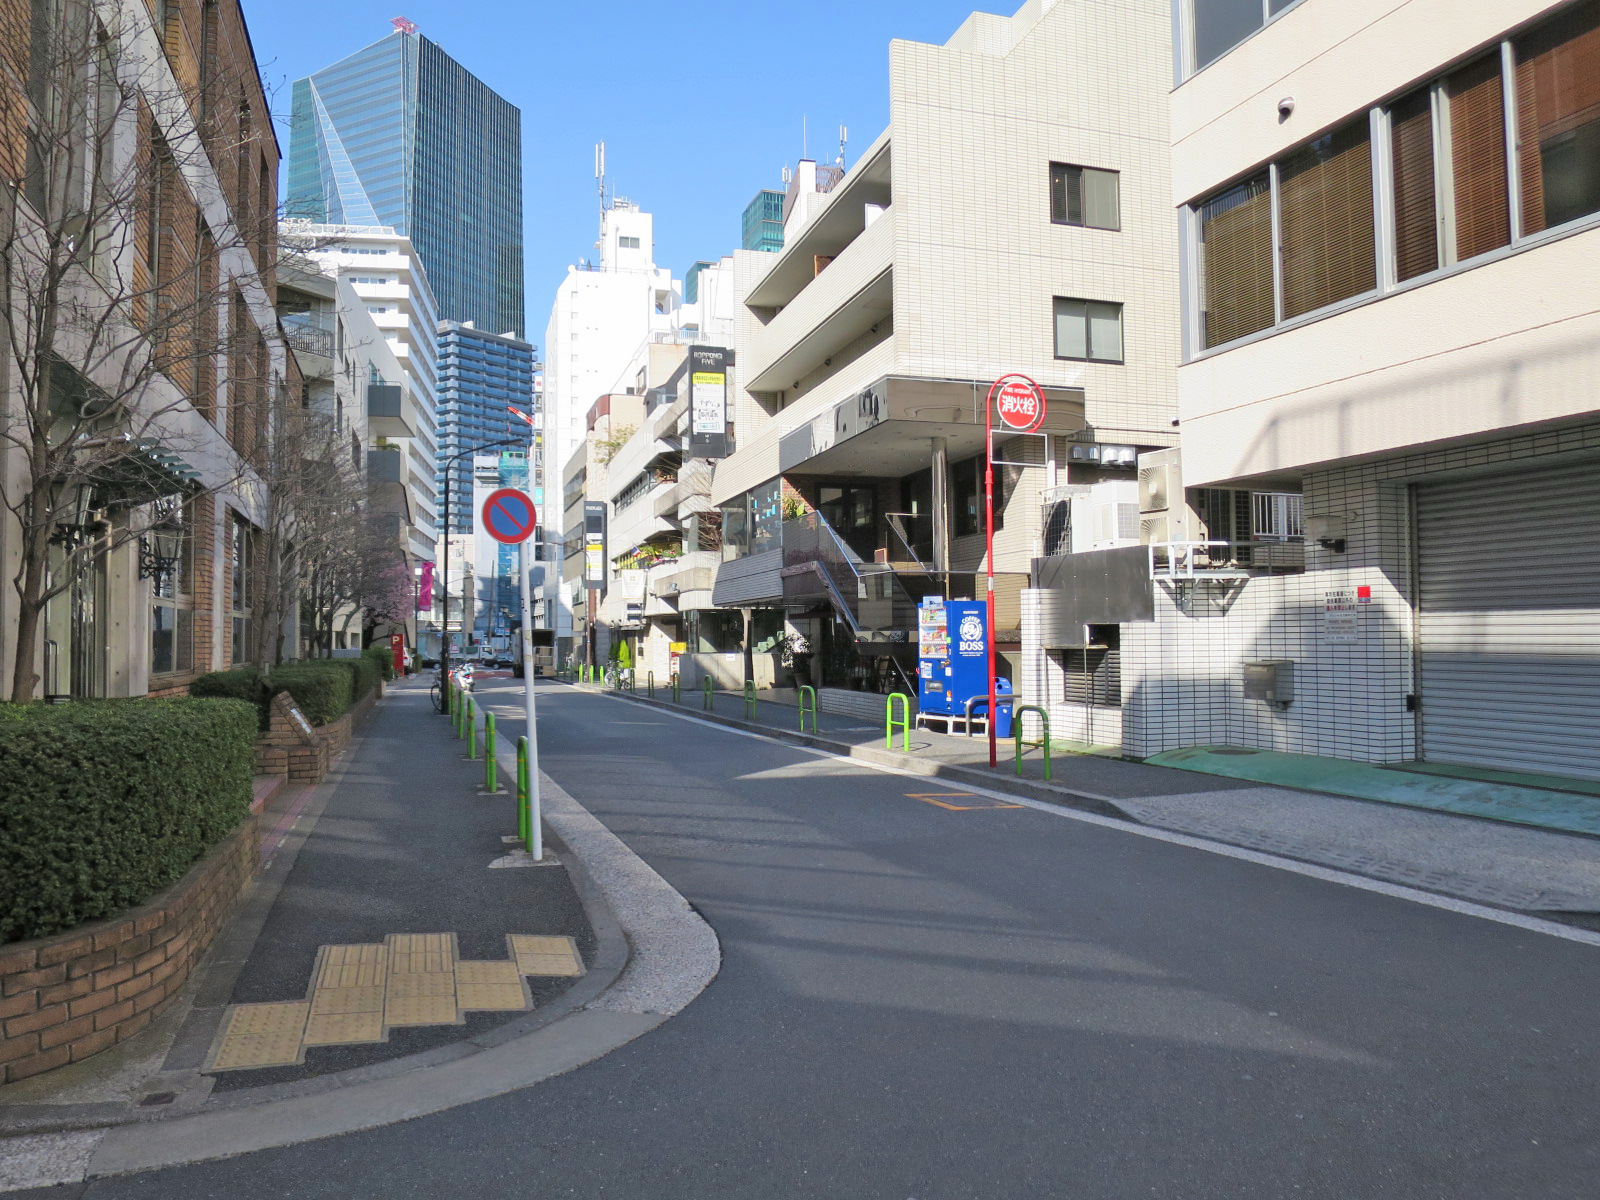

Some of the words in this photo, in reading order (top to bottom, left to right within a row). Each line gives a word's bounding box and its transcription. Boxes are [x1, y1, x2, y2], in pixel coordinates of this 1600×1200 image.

[693, 351, 723, 360] ROPPONGI
[701, 358, 716, 366] FIVE
[1001, 394, 1036, 415] 消火栓
[961, 615, 981, 624] COFFEE
[392, 635, 400, 645] P
[959, 641, 984, 651] BOSS
